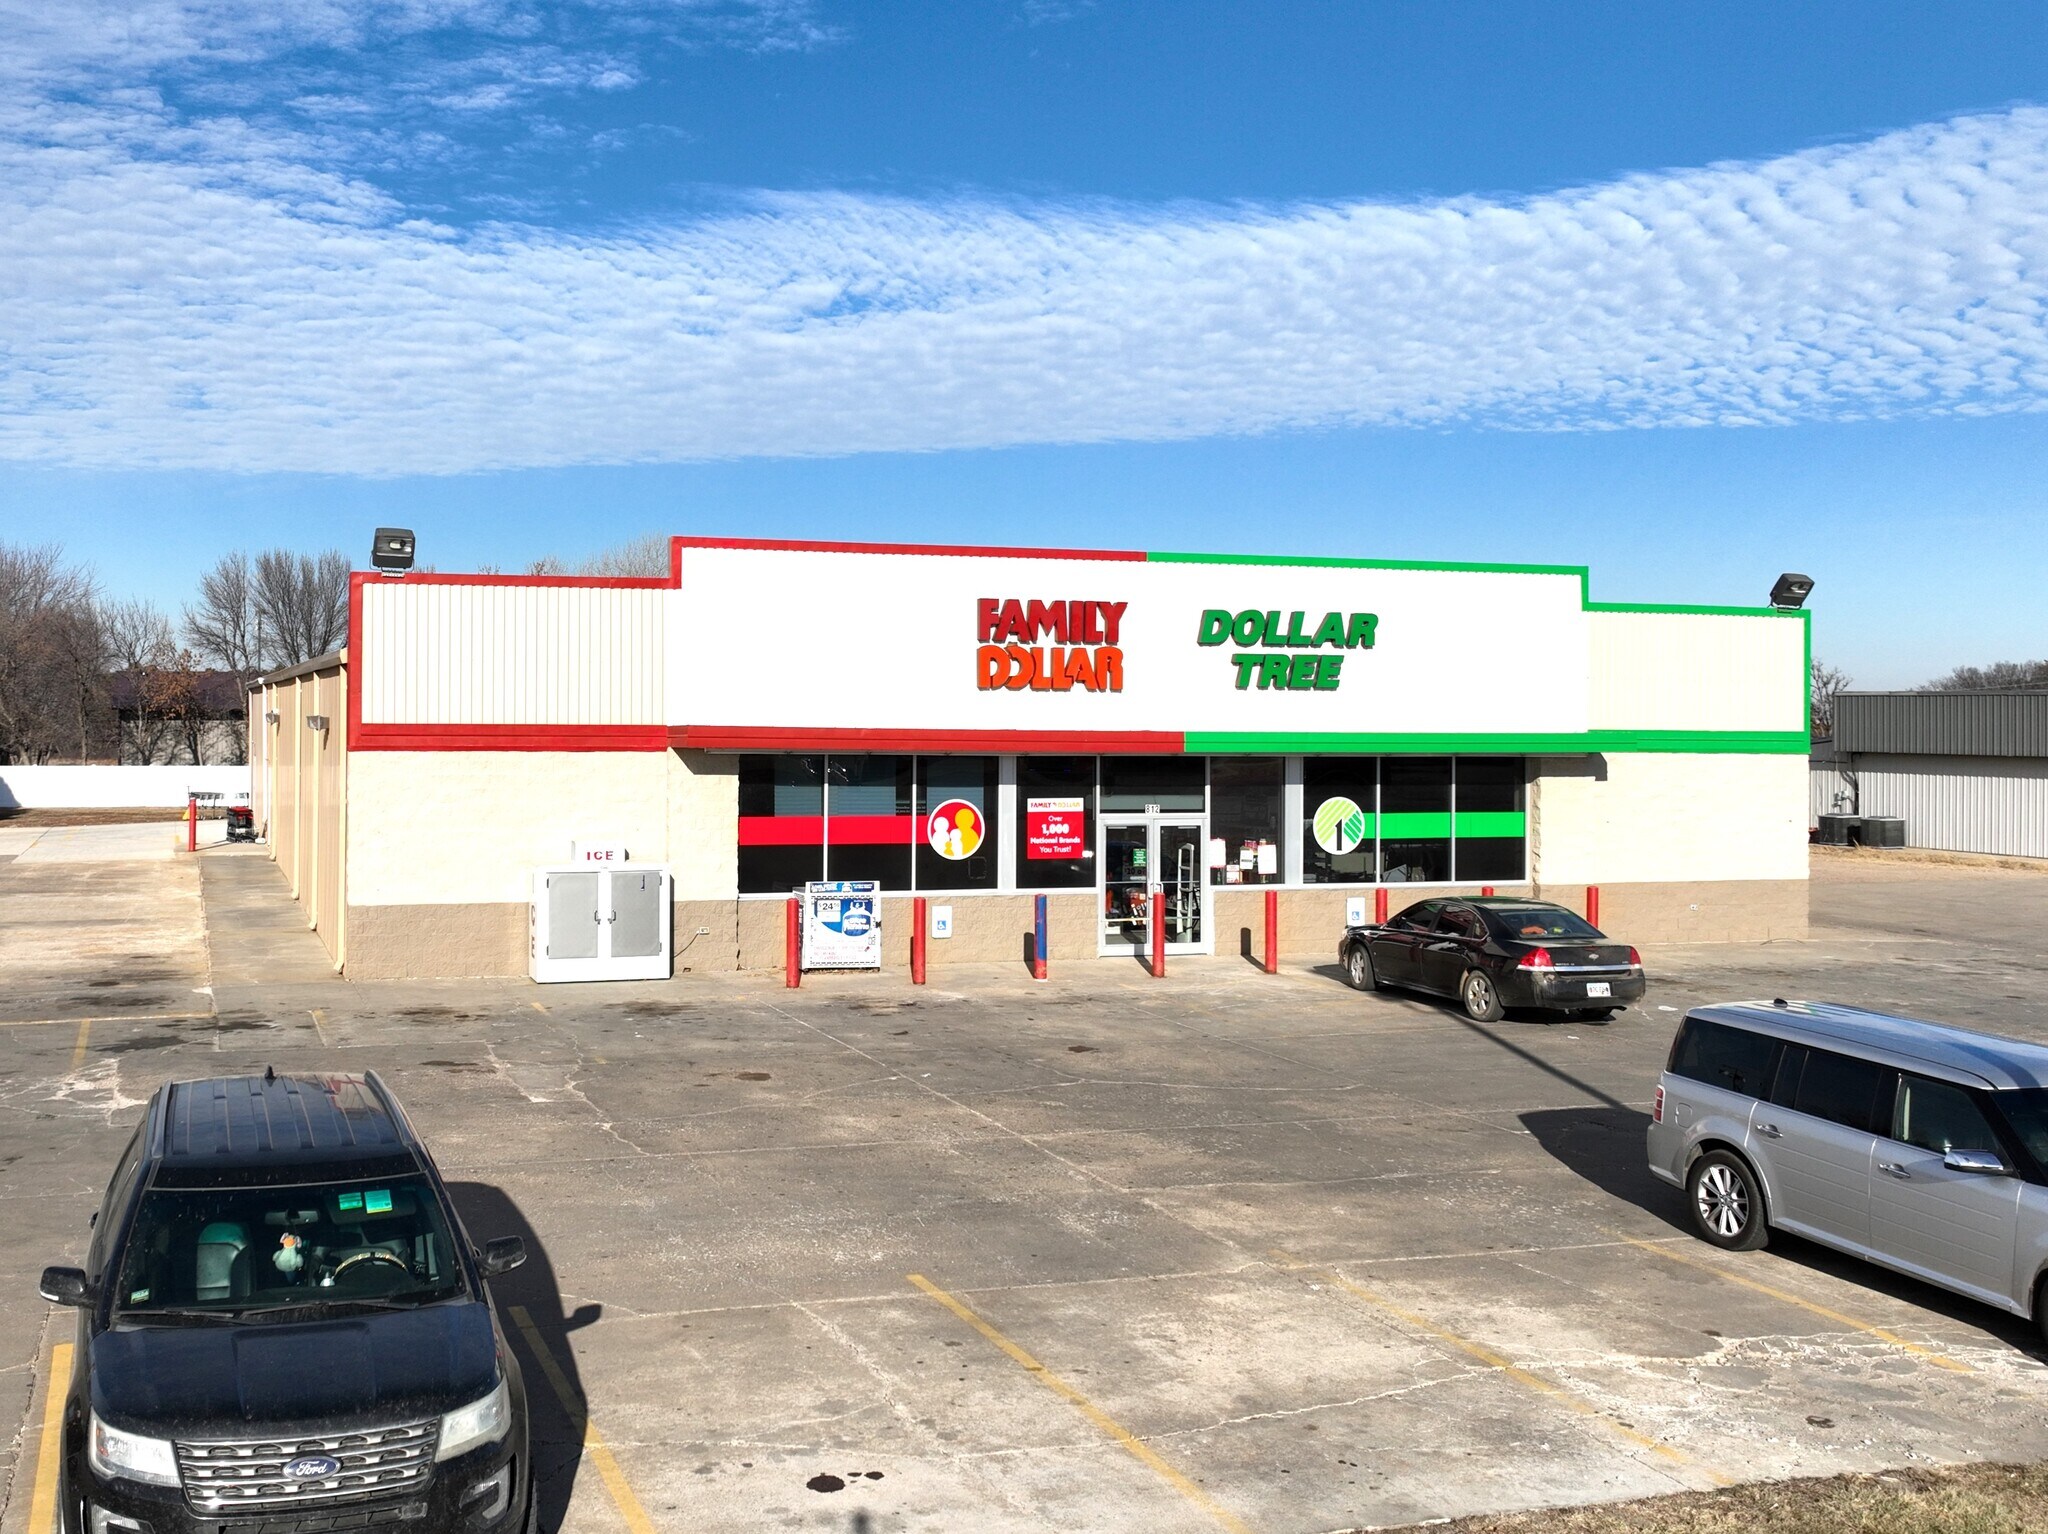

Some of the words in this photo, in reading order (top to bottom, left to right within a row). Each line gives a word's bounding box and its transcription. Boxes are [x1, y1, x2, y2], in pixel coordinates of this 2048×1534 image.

[977, 598, 1128, 645] FAMILY
[1197, 609, 1379, 649] DOLLAR
[977, 644, 1124, 693] DOLLAR
[1231, 653, 1345, 691] TREE
[1145, 805, 1160, 813] 812
[1042, 824, 1069, 836] 1,000
[1059, 836, 1081, 844] Brands
[586, 850, 614, 861] ICE
[296, 1460, 328, 1476] Ford
